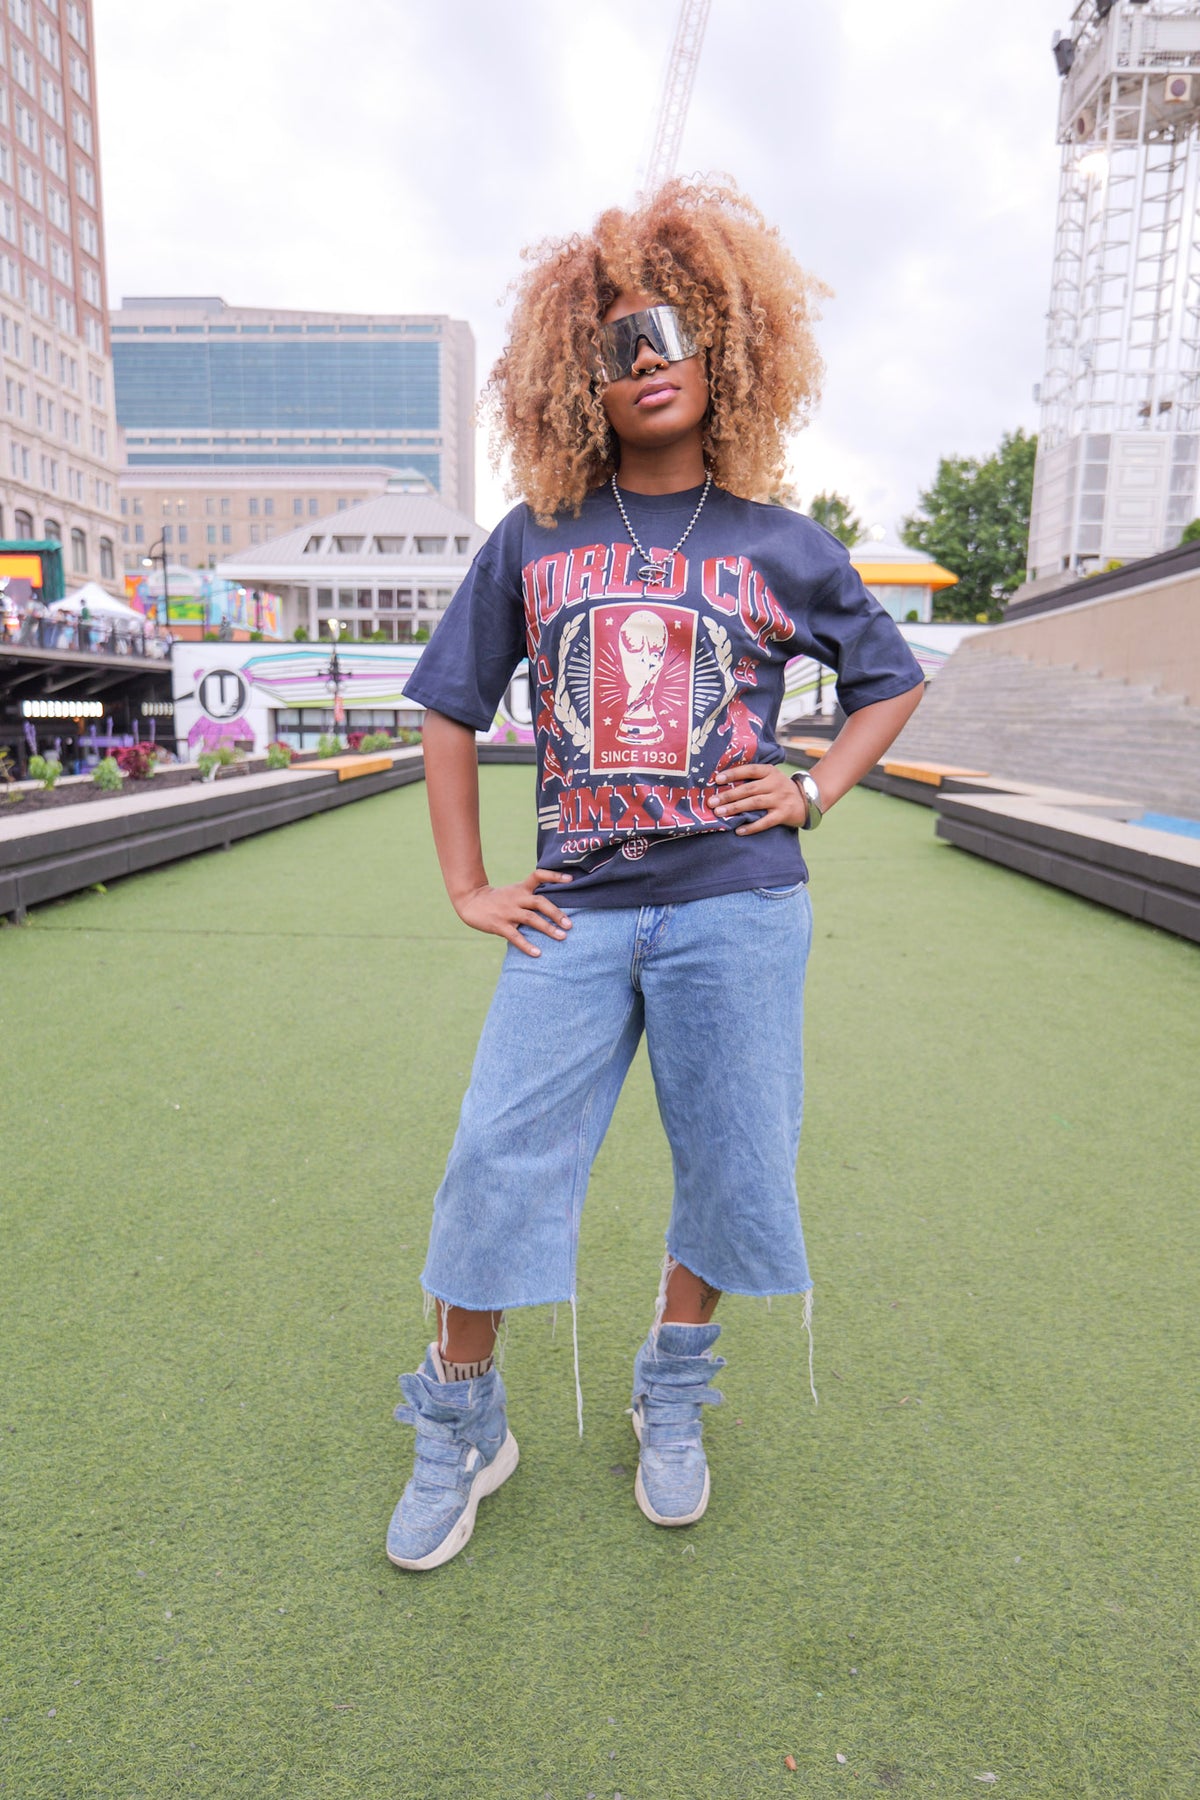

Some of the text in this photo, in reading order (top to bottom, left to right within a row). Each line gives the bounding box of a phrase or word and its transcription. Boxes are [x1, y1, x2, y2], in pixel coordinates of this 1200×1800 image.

[702, 555, 796, 657] CUP
[600, 750, 678, 765] SINCE 1930
